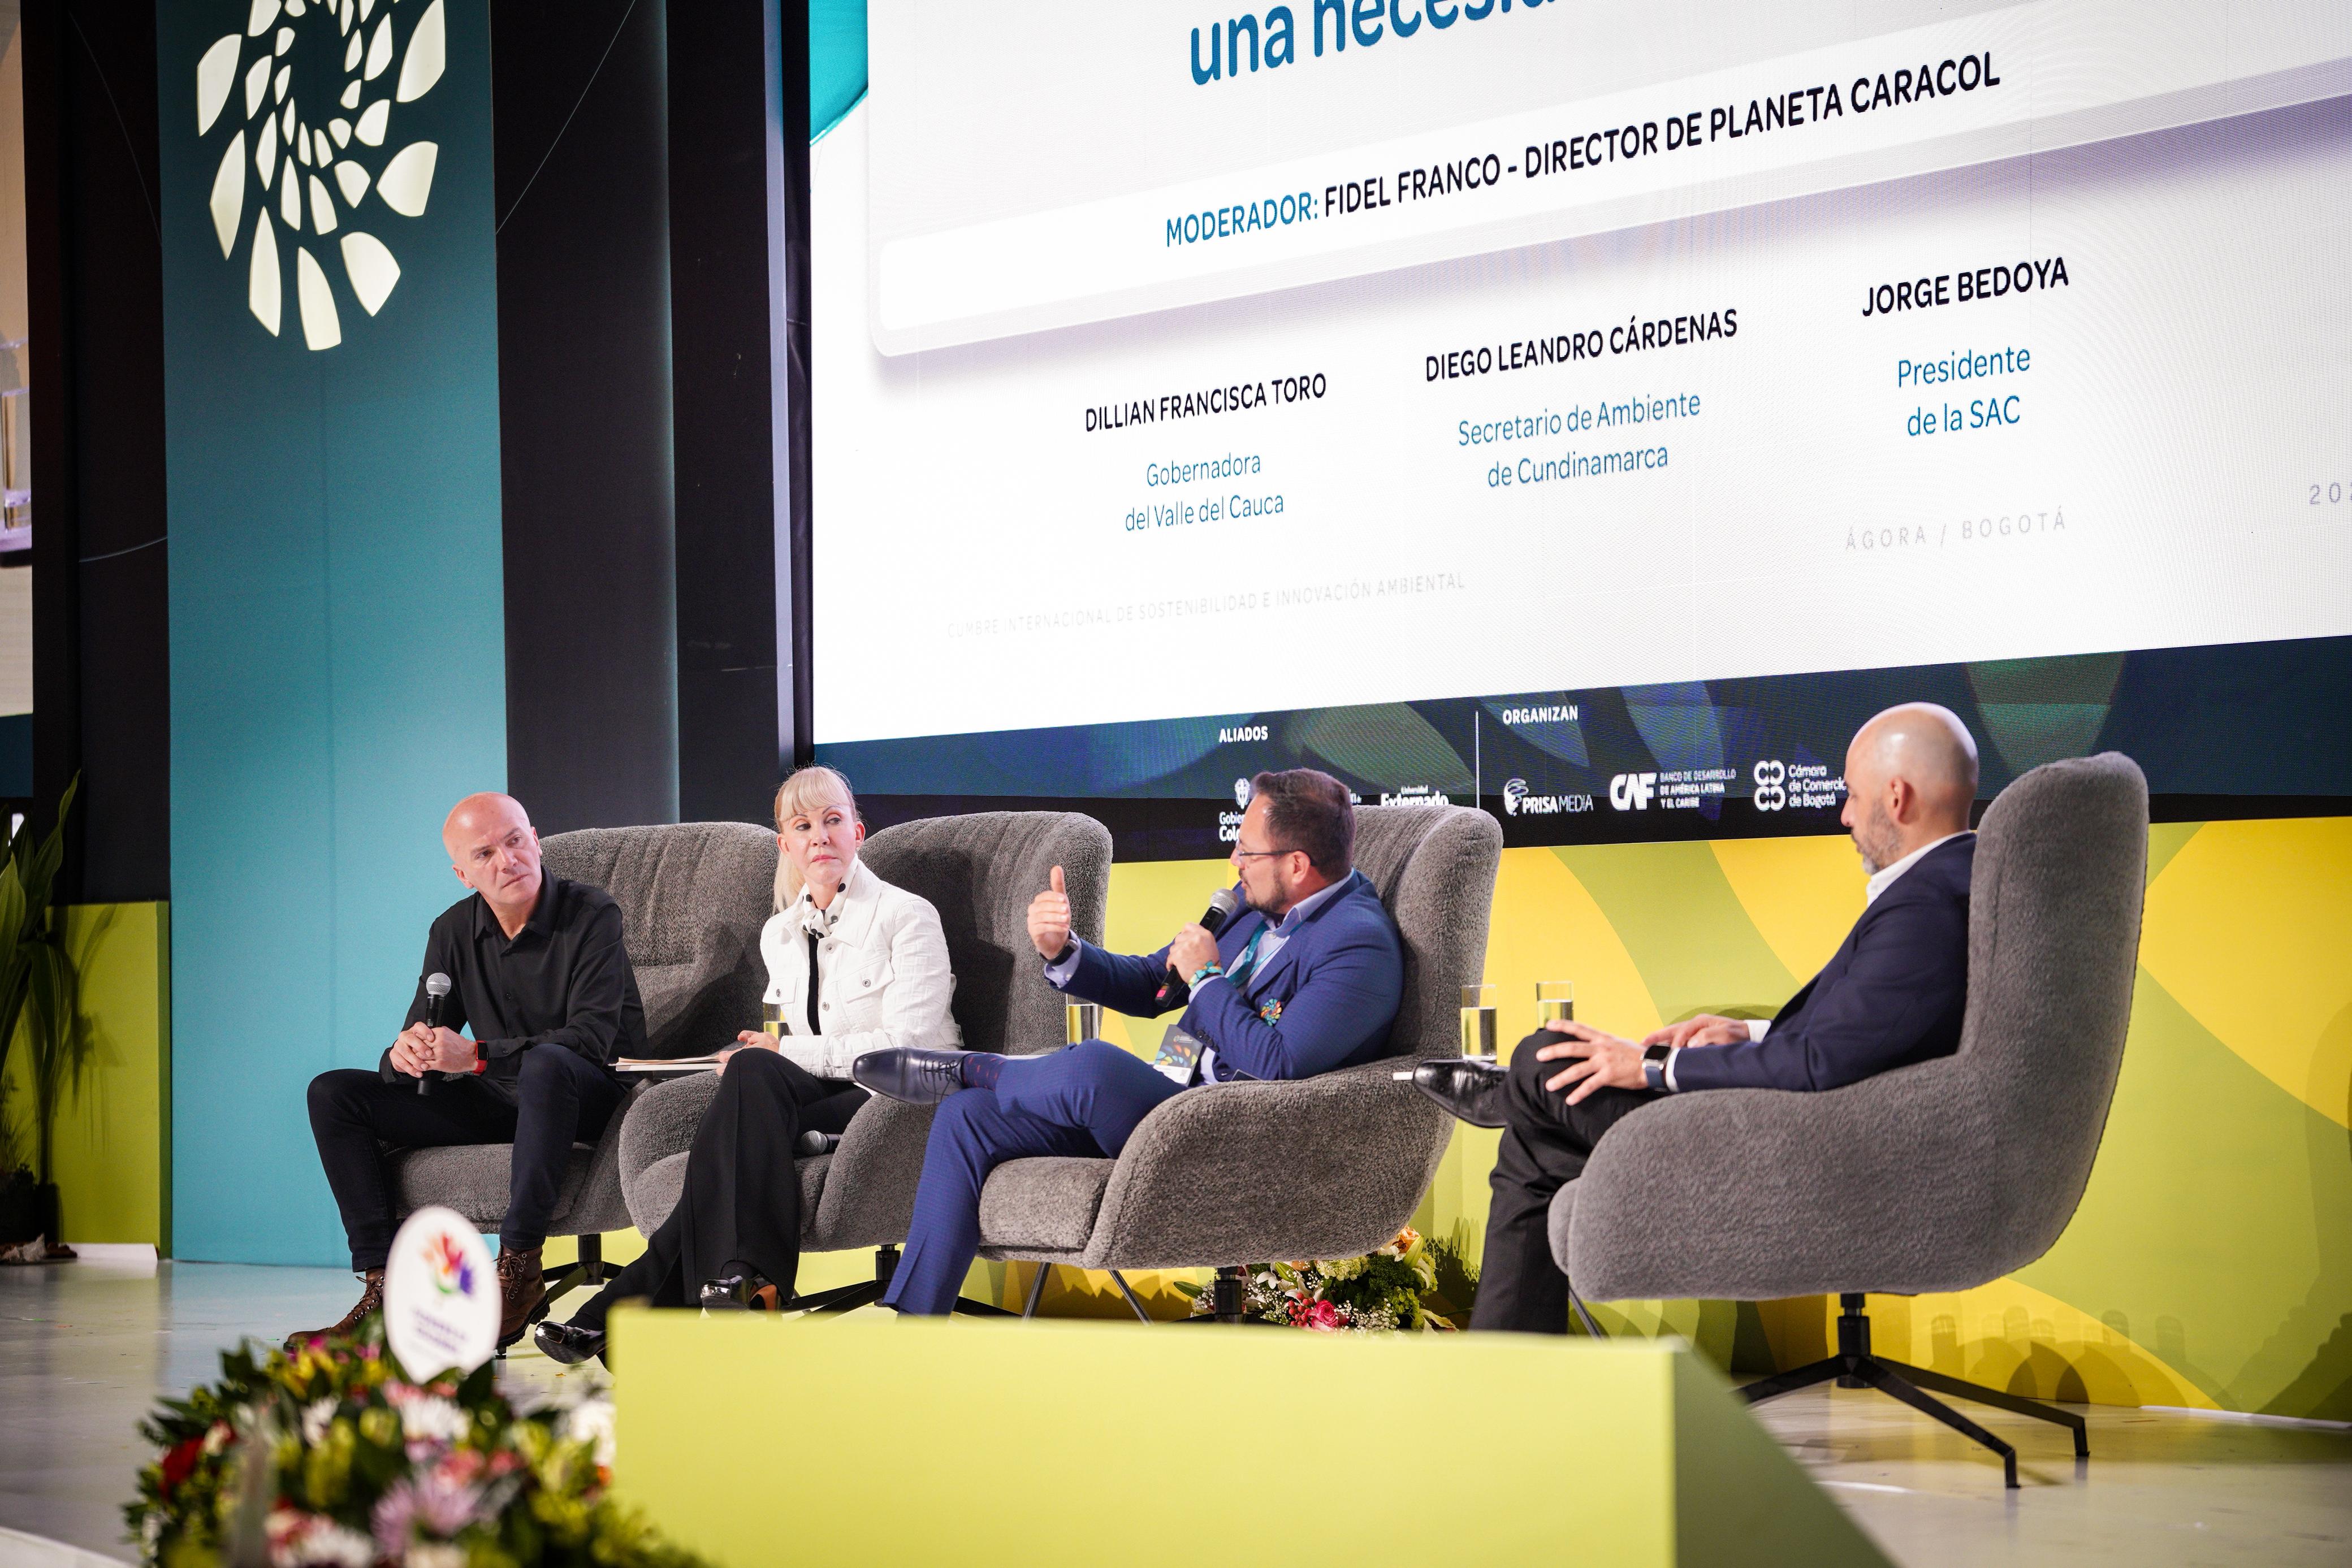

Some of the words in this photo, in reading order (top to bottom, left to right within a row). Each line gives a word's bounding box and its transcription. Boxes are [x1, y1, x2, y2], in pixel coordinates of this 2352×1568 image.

[1191, 5, 1294, 85] una
[1166, 192, 1318, 248] MODERADOR:
[1325, 176, 1391, 217] FIDEL
[1398, 154, 1501, 203] FRANCO
[1525, 122, 1658, 178] DIRECTOR
[1666, 112, 1702, 151] DE
[1710, 84, 1843, 142] PLANETA
[1851, 51, 2000, 113] CARACOL
[1862, 275, 1950, 317] JORGE
[1957, 257, 2069, 302] BEDOYA
[1425, 347, 1492, 382] DIEGO
[1498, 330, 1603, 371] LEANDRO
[1610, 309, 1738, 354] CÁRDENAS
[1897, 346, 2031, 388] Presidente
[1085, 399, 1155, 432] DILLIAN
[1160, 382, 1266, 420] FRANCISCA
[1272, 372, 1326, 405] TORO
[1458, 408, 1562, 447] Secretario
[1567, 404, 1592, 431] de
[1597, 392, 1701, 428] Ambiente
[1907, 408, 1936, 436] de
[1944, 403, 1963, 432] la
[1970, 395, 2021, 429] SAC
[1146, 453, 1261, 487] Gobernadora
[1488, 461, 1512, 488] de
[1517, 445, 1668, 484] Cundinamarca
[1125, 503, 1150, 532] del
[1154, 499, 1194, 527] Valle
[1199, 495, 1225, 522] del
[1229, 492, 1285, 519] Cauca
[2308, 482, 2352, 505] 20
[1845, 526, 1927, 551] ÁGORA
[1962, 505, 2065, 540] BOGOTÁ
[948, 618, 999, 638] CUMBRE
[1004, 607, 1112, 634] INTERNACIONAL
[1117, 605, 1134, 622] DE
[1139, 592, 1257, 621] SOSTENIBILIDAD
[1262, 591, 1271, 608] E
[1276, 578, 1372, 607] INNOVACIÓN
[1376, 571, 1466, 597] AMBIENTAL
[1218, 726, 1268, 743] ALIADOS
[1502, 705, 1579, 726] ORGANIZAN
[1610, 773, 1658, 811] CAF
[1788, 779, 1802, 792] de
[1788, 793, 1802, 808] de
